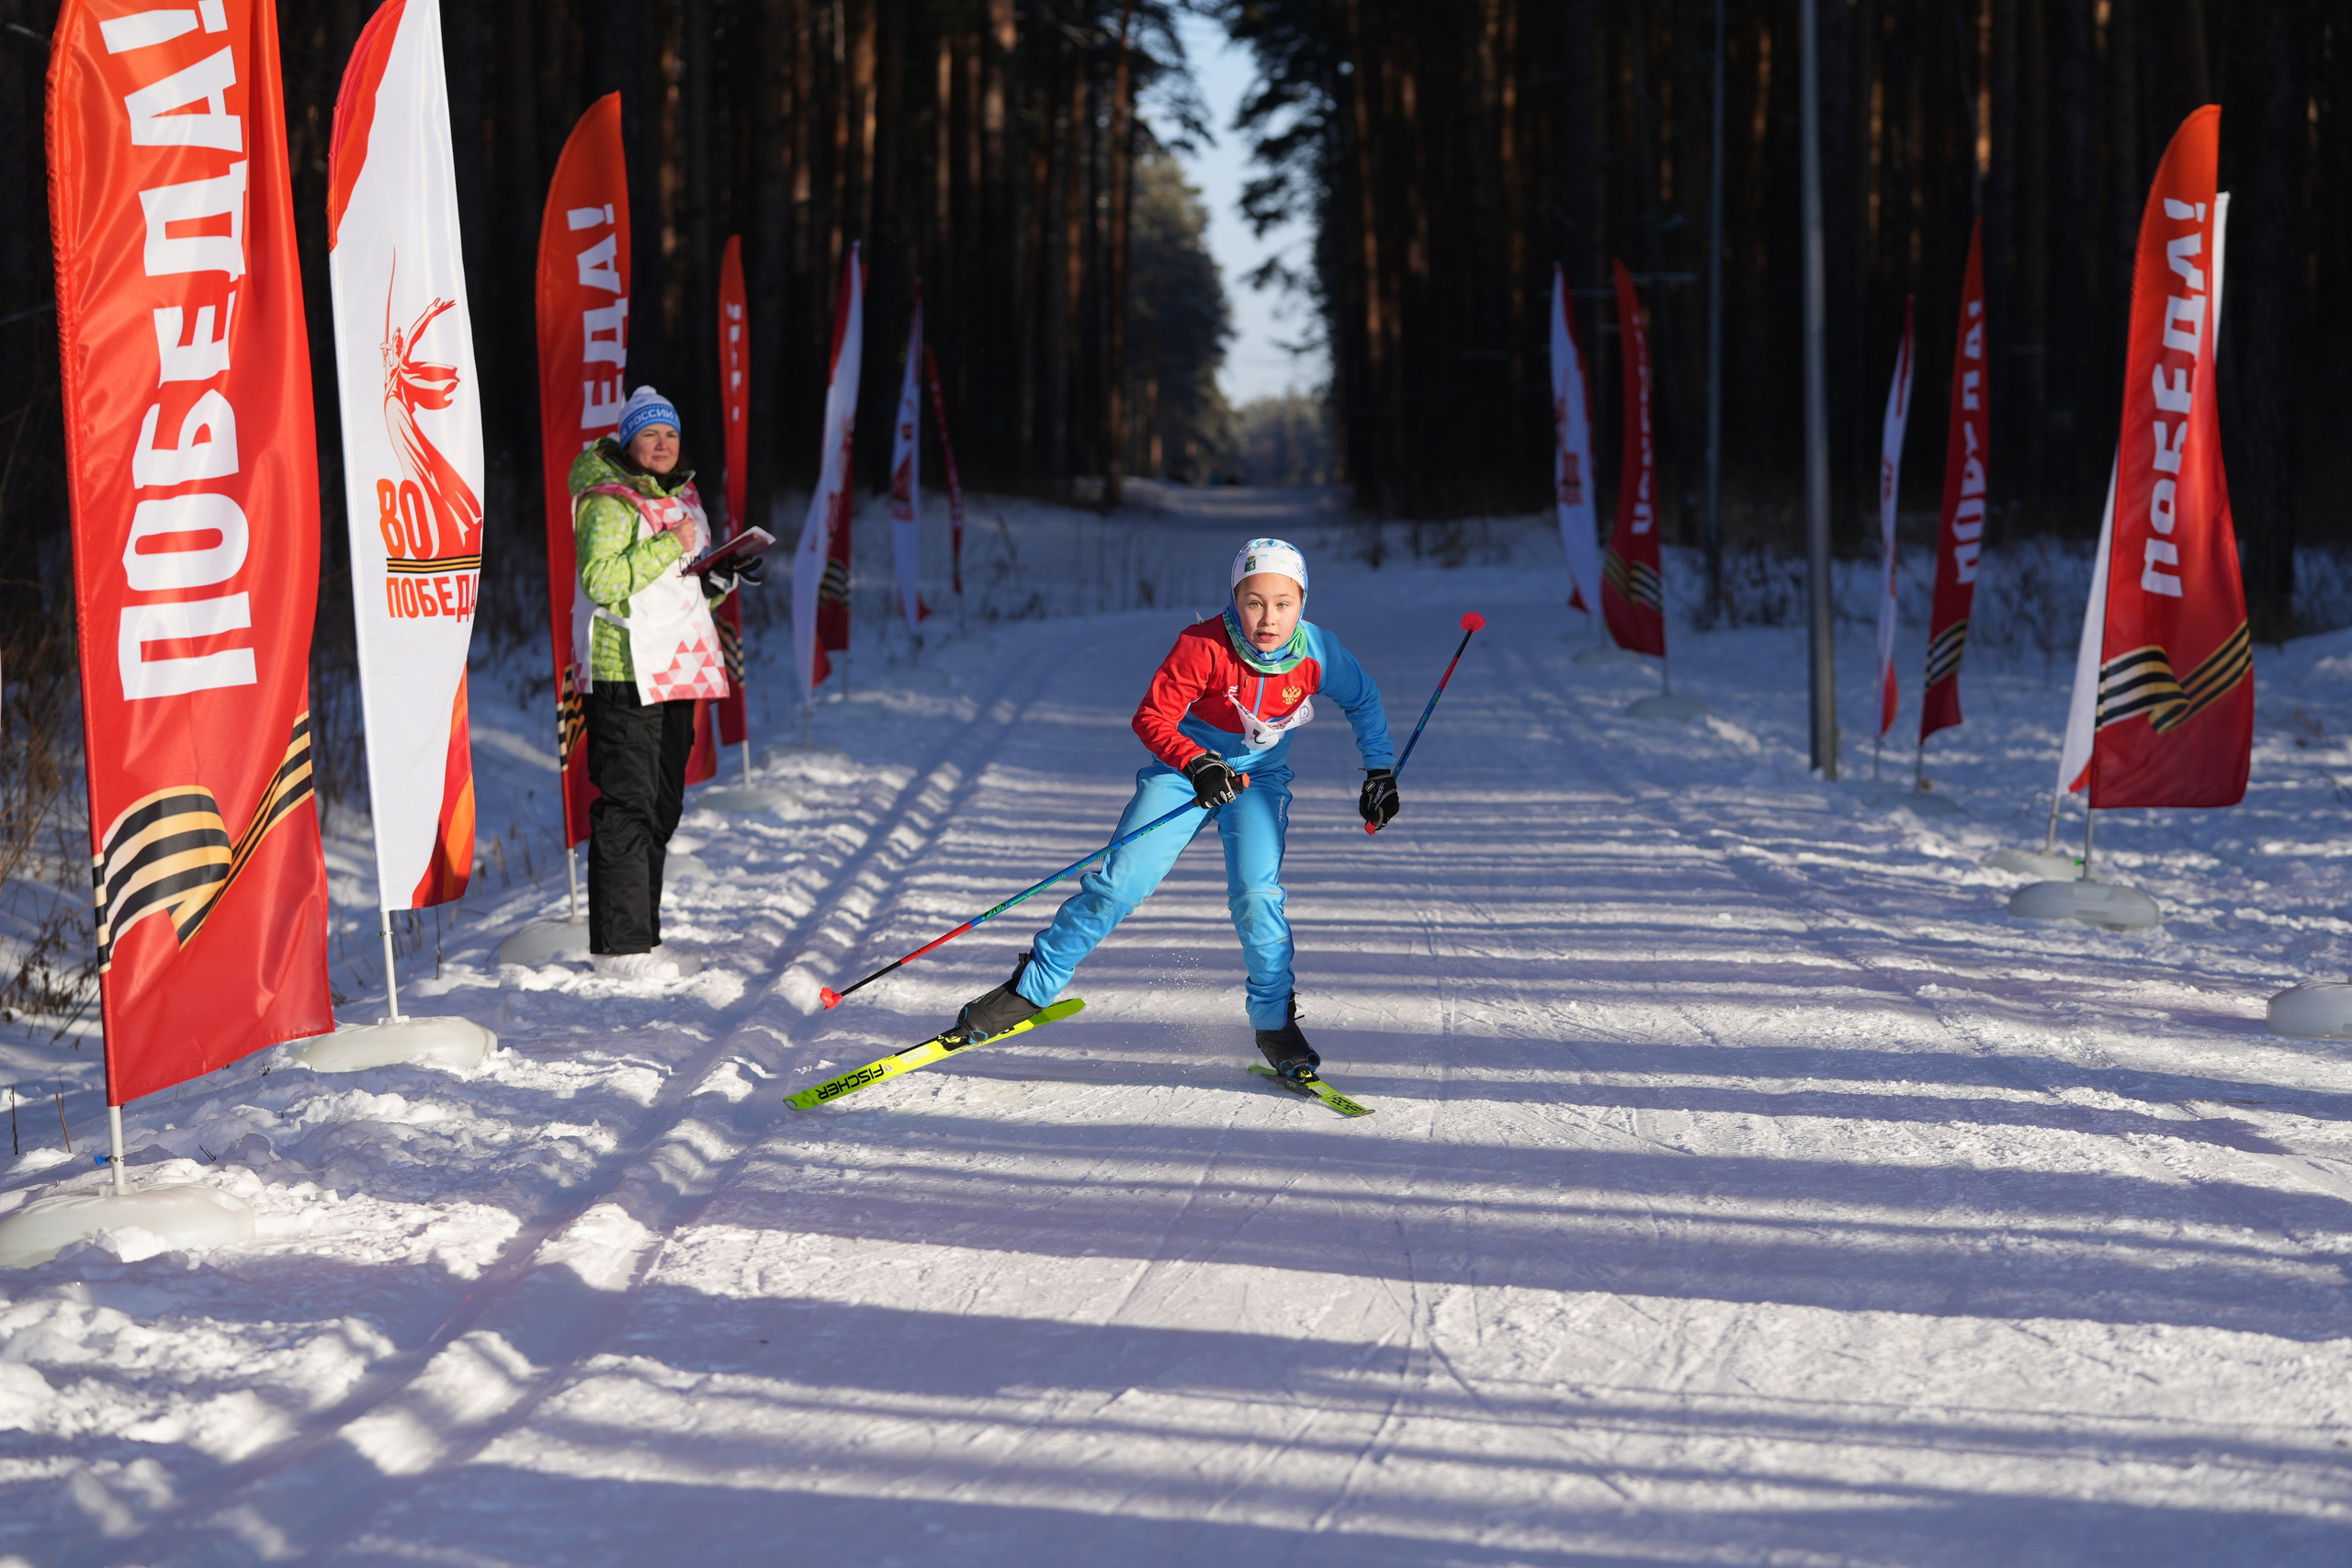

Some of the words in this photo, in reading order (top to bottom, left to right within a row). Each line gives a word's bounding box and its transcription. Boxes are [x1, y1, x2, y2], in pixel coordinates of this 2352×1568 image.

[98, 0, 256, 701] ПОБЕДА!
[567, 203, 628, 450] ЕДА!
[628, 408, 674, 430] РОССИИ
[377, 479, 433, 560] 80
[816, 1065, 885, 1100] FISCHER
